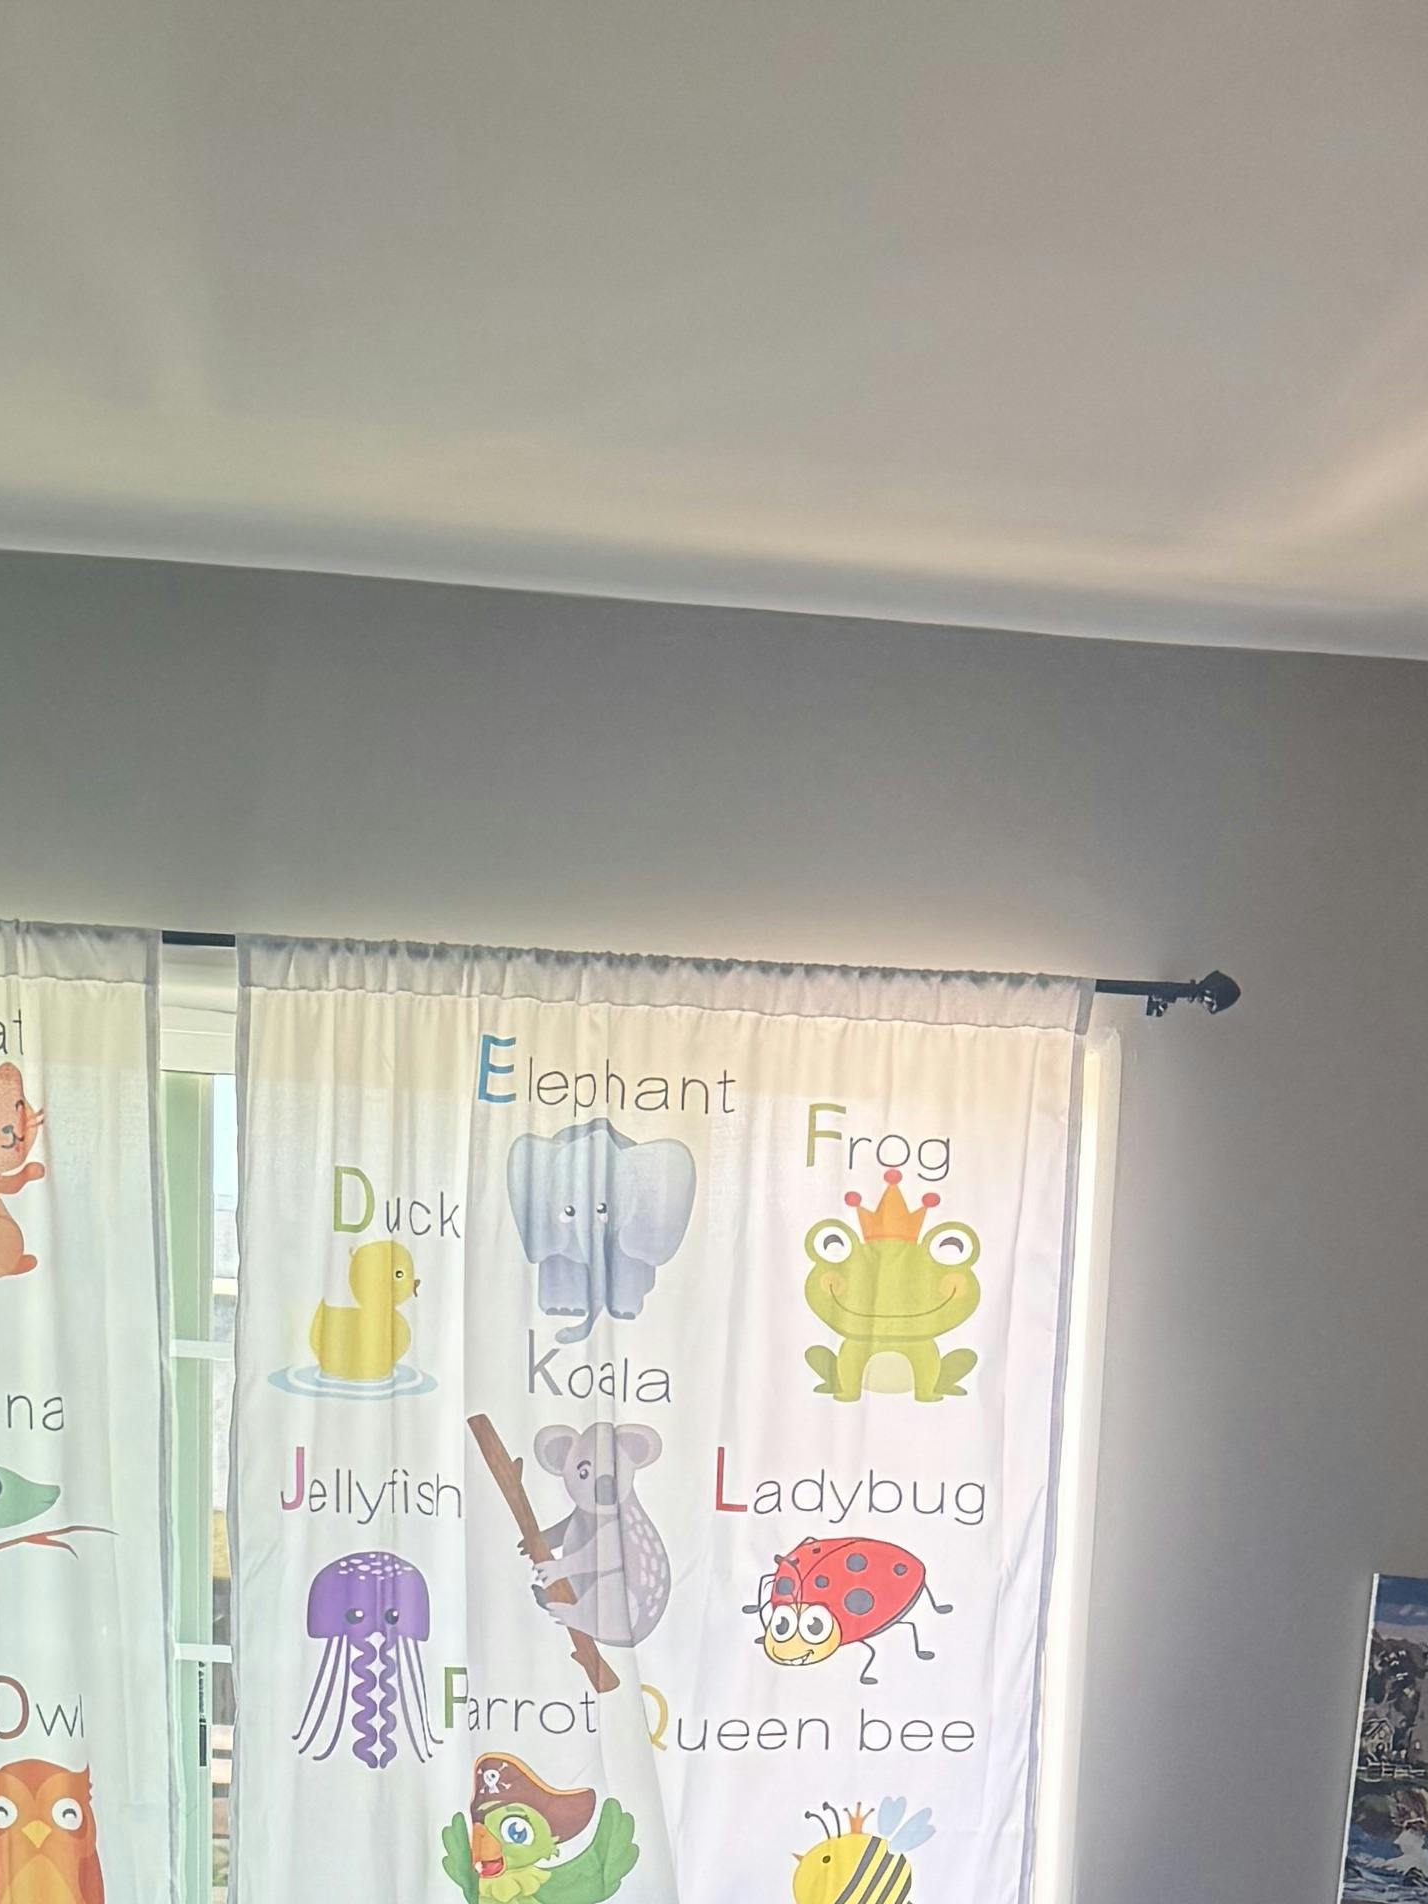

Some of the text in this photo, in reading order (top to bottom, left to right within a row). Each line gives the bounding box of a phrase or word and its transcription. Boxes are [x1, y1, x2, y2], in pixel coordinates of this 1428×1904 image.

[477, 1034, 736, 1115] Elephant
[805, 1104, 952, 1182] Frog
[332, 1165, 462, 1240] Duck
[527, 1329, 671, 1405] Koala
[280, 1446, 462, 1525] Jellyfish
[714, 1447, 986, 1525] Ladybug
[444, 1667, 597, 1734] Parrot
[859, 1709, 975, 1753] bee
